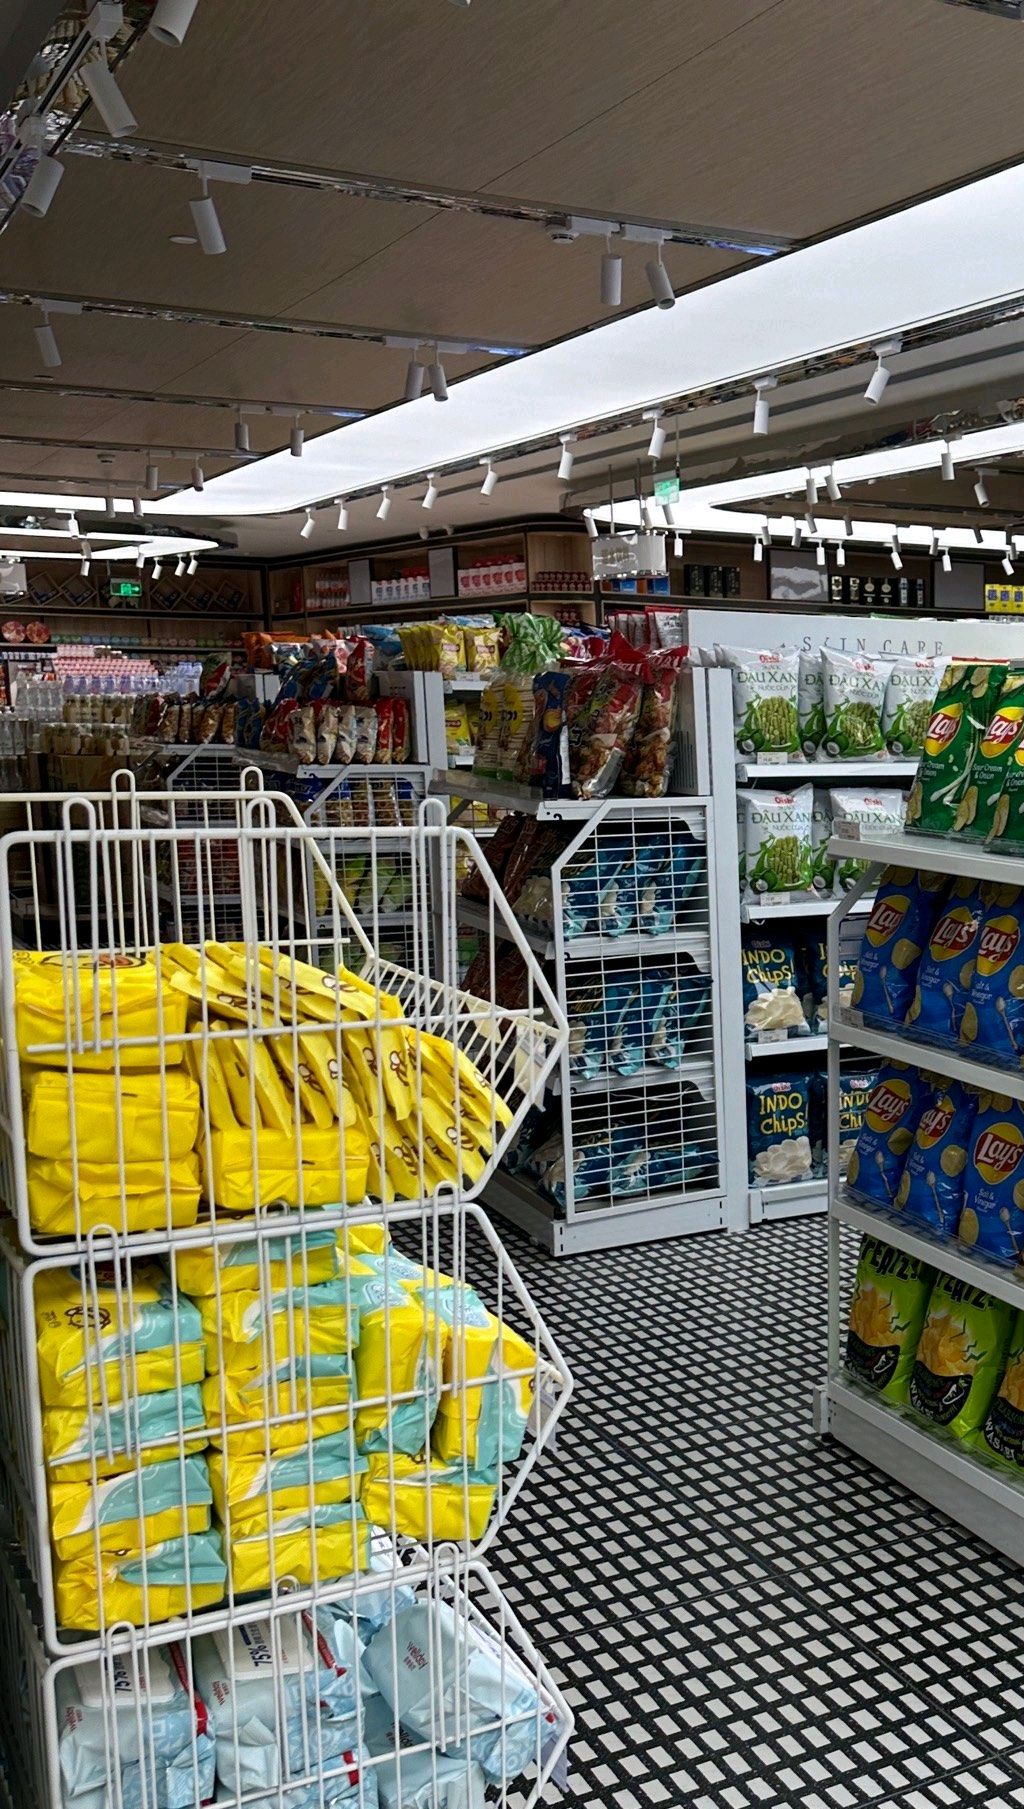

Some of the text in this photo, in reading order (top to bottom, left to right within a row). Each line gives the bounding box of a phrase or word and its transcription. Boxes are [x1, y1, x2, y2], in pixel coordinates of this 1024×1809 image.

[883, 639, 943, 656] CARE
[743, 948, 786, 965] INDO
[759, 1092, 803, 1115] INDO
[977, 1133, 1024, 1171] Lay's
